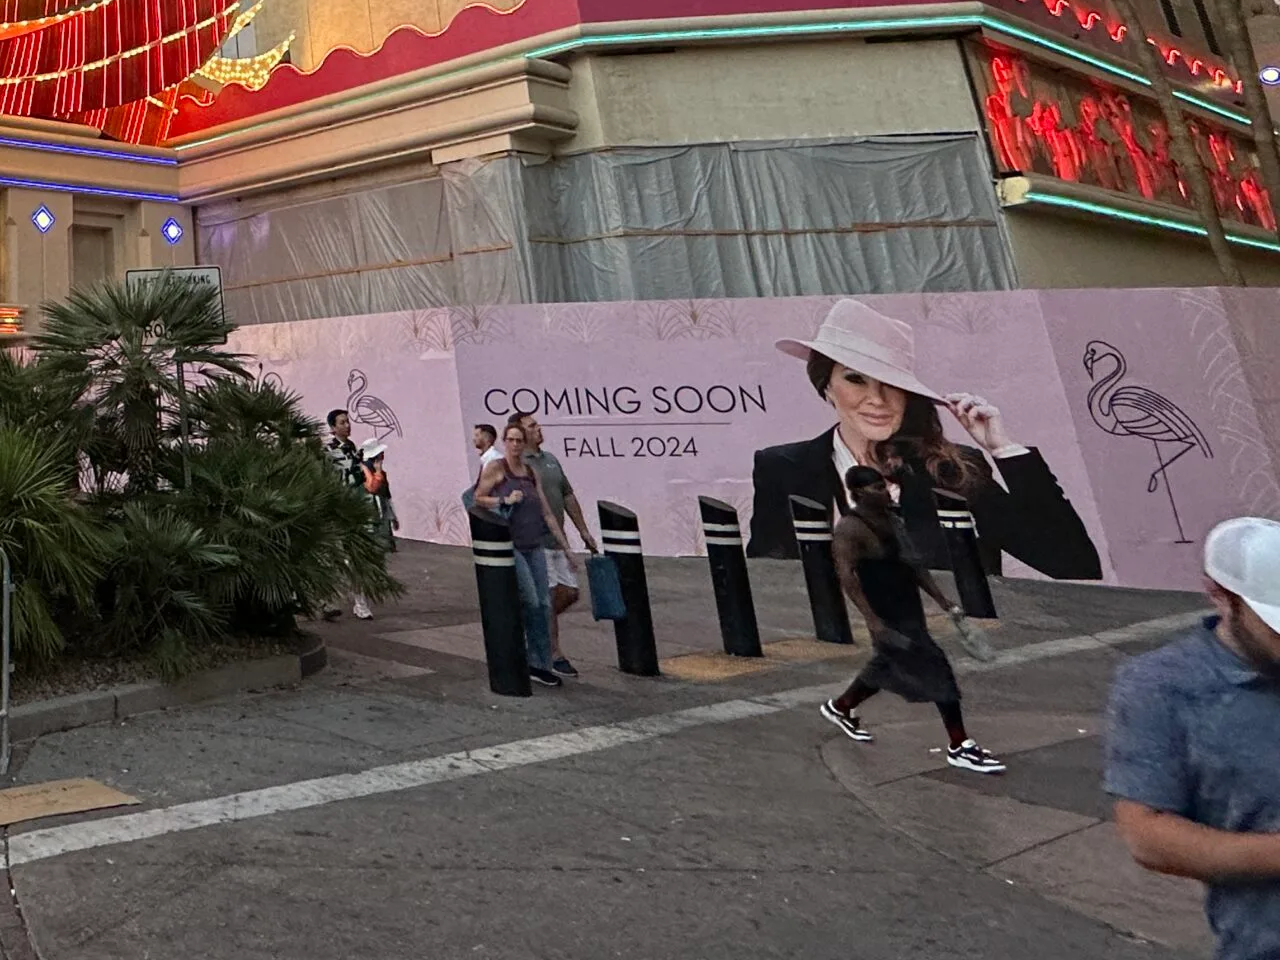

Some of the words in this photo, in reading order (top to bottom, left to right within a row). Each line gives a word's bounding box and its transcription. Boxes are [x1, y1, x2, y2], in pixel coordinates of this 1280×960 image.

[483, 386, 642, 416] COMING
[652, 384, 767, 414] SOON
[563, 437, 625, 458] FALL
[631, 436, 699, 458] 2024
